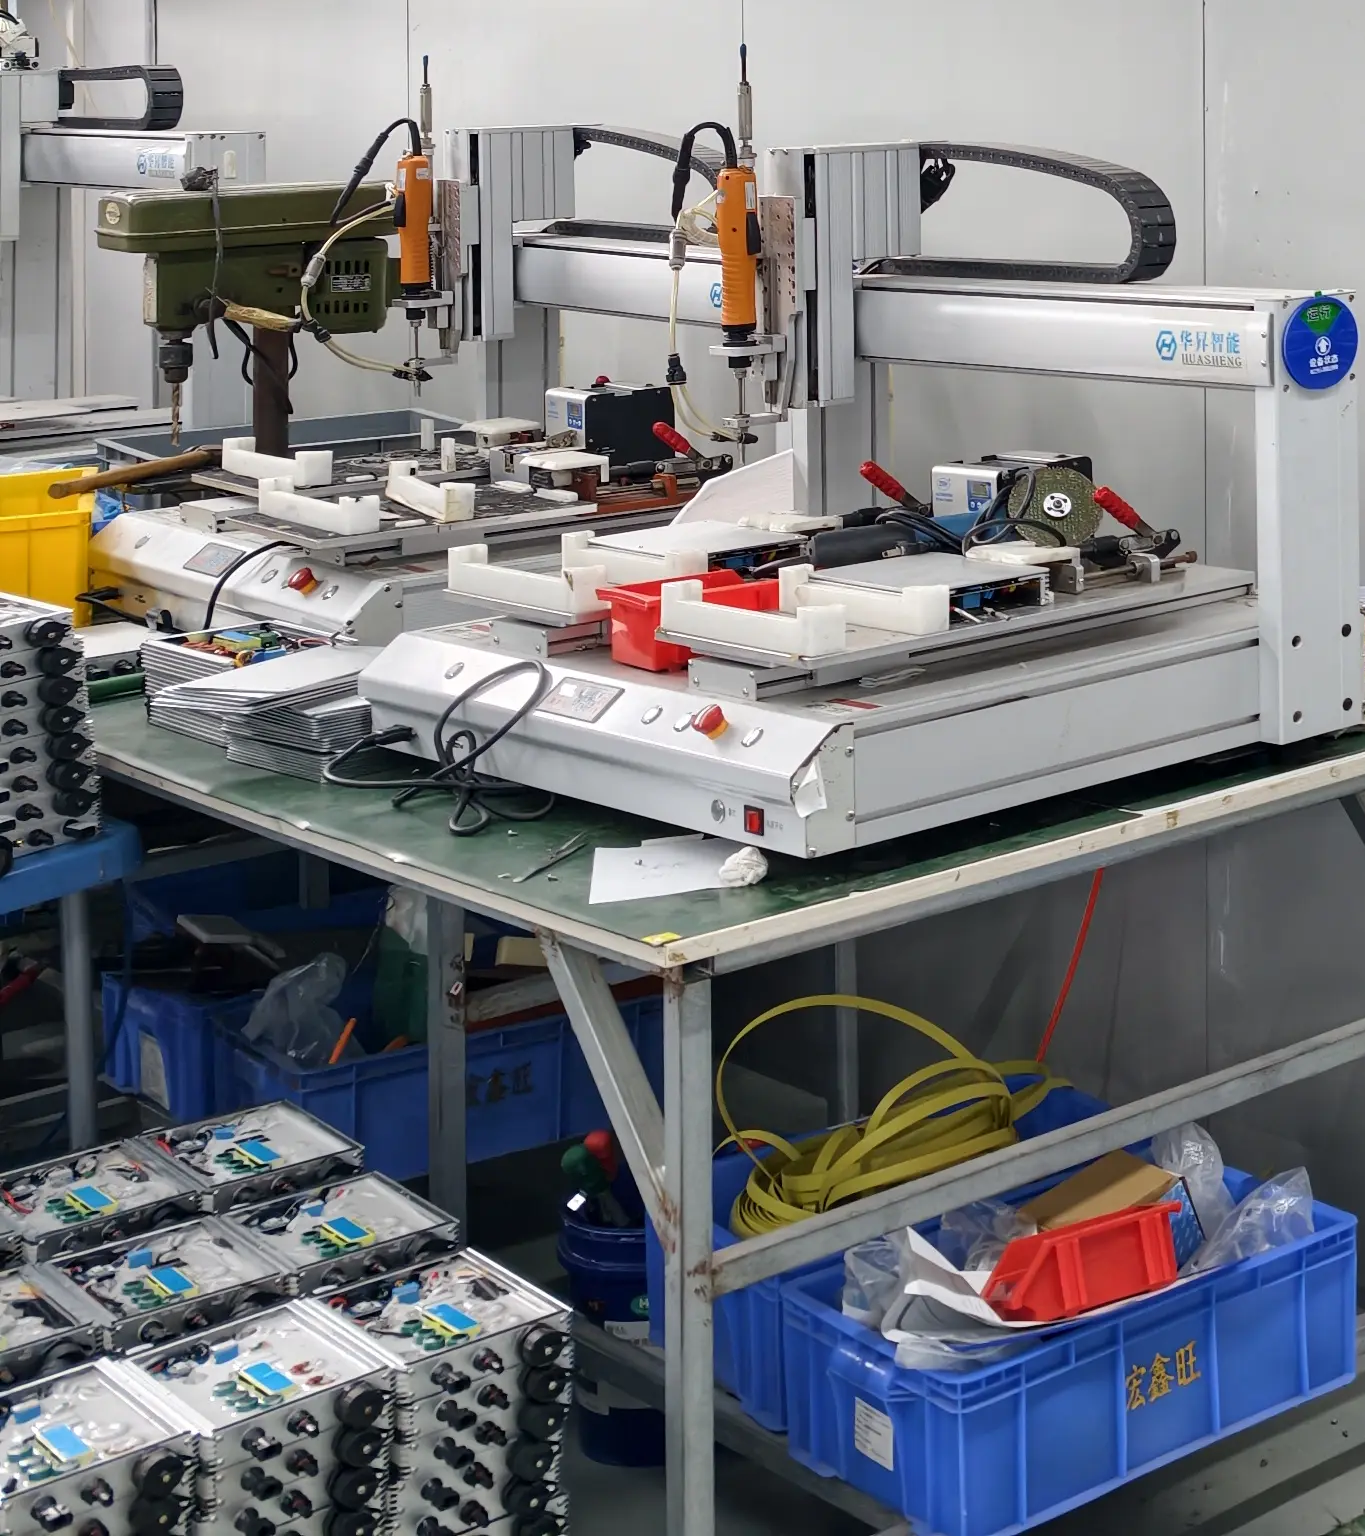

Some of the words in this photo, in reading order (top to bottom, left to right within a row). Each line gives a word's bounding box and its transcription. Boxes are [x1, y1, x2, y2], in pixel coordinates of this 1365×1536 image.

[1306, 304, 1331, 322] 运行
[1180, 330, 1241, 354] 华昇智能
[1181, 353, 1243, 368] HUASHENG
[1125, 1340, 1201, 1411] 宏鑫旺
